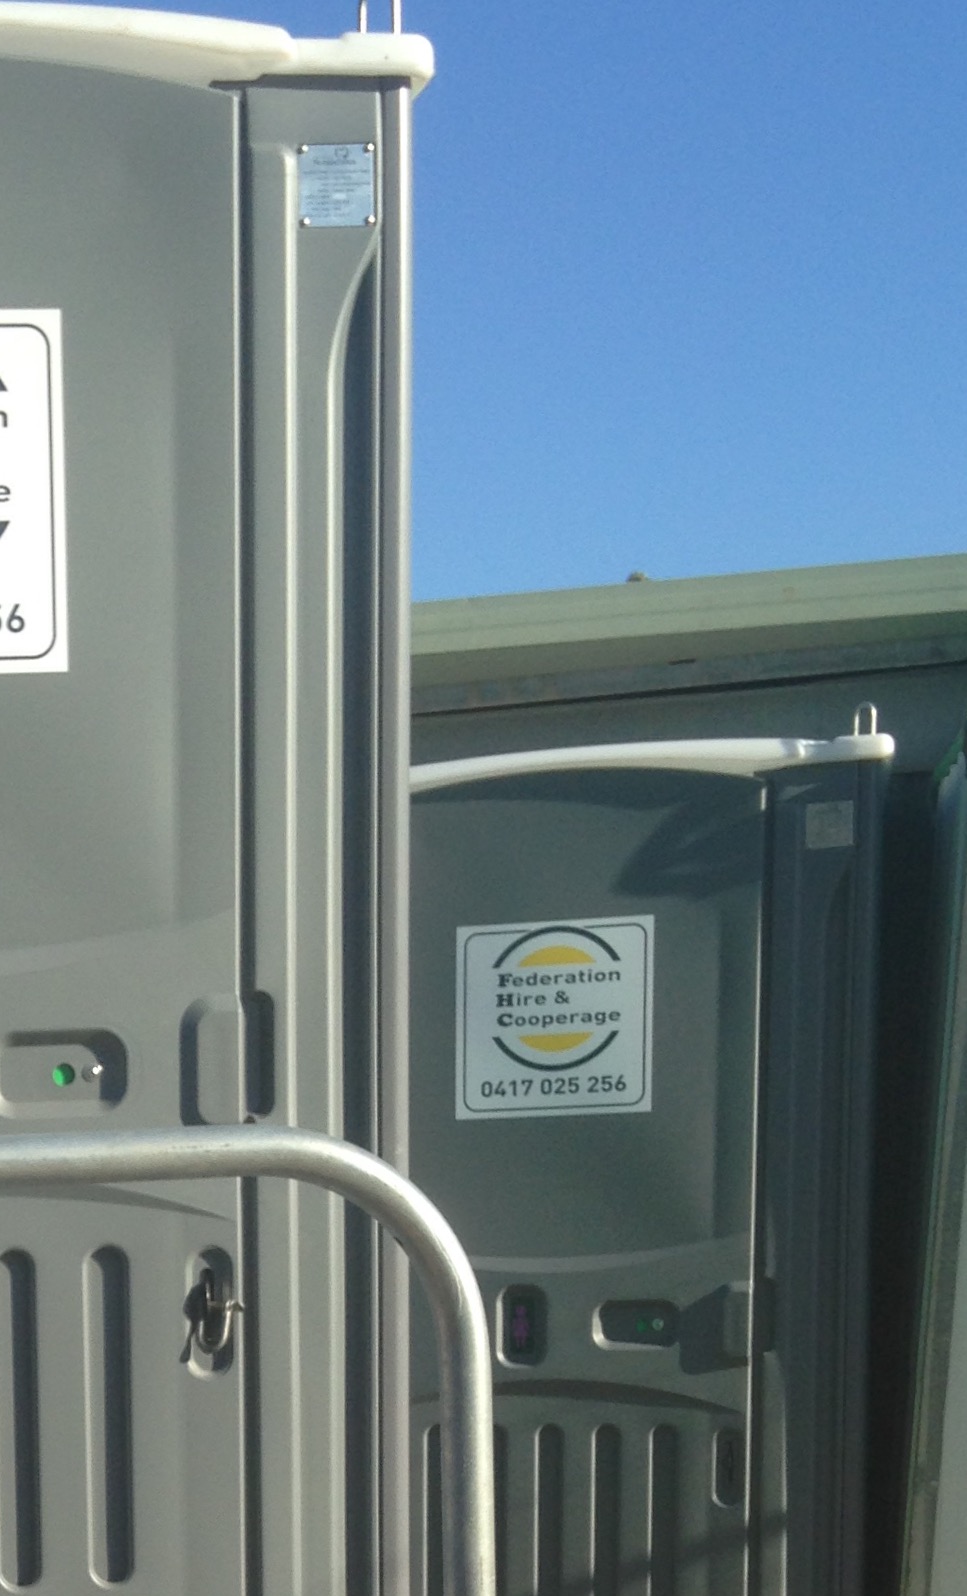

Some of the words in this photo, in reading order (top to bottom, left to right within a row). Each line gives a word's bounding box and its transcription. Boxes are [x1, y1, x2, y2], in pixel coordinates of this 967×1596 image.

[497, 969, 622, 987] Federation
[495, 992, 547, 1008] Hire
[554, 990, 570, 1005] &
[496, 1011, 621, 1029] Cooperage
[480, 1078, 534, 1098] 0417
[540, 1076, 580, 1096] 025
[586, 1074, 627, 1094] 256
